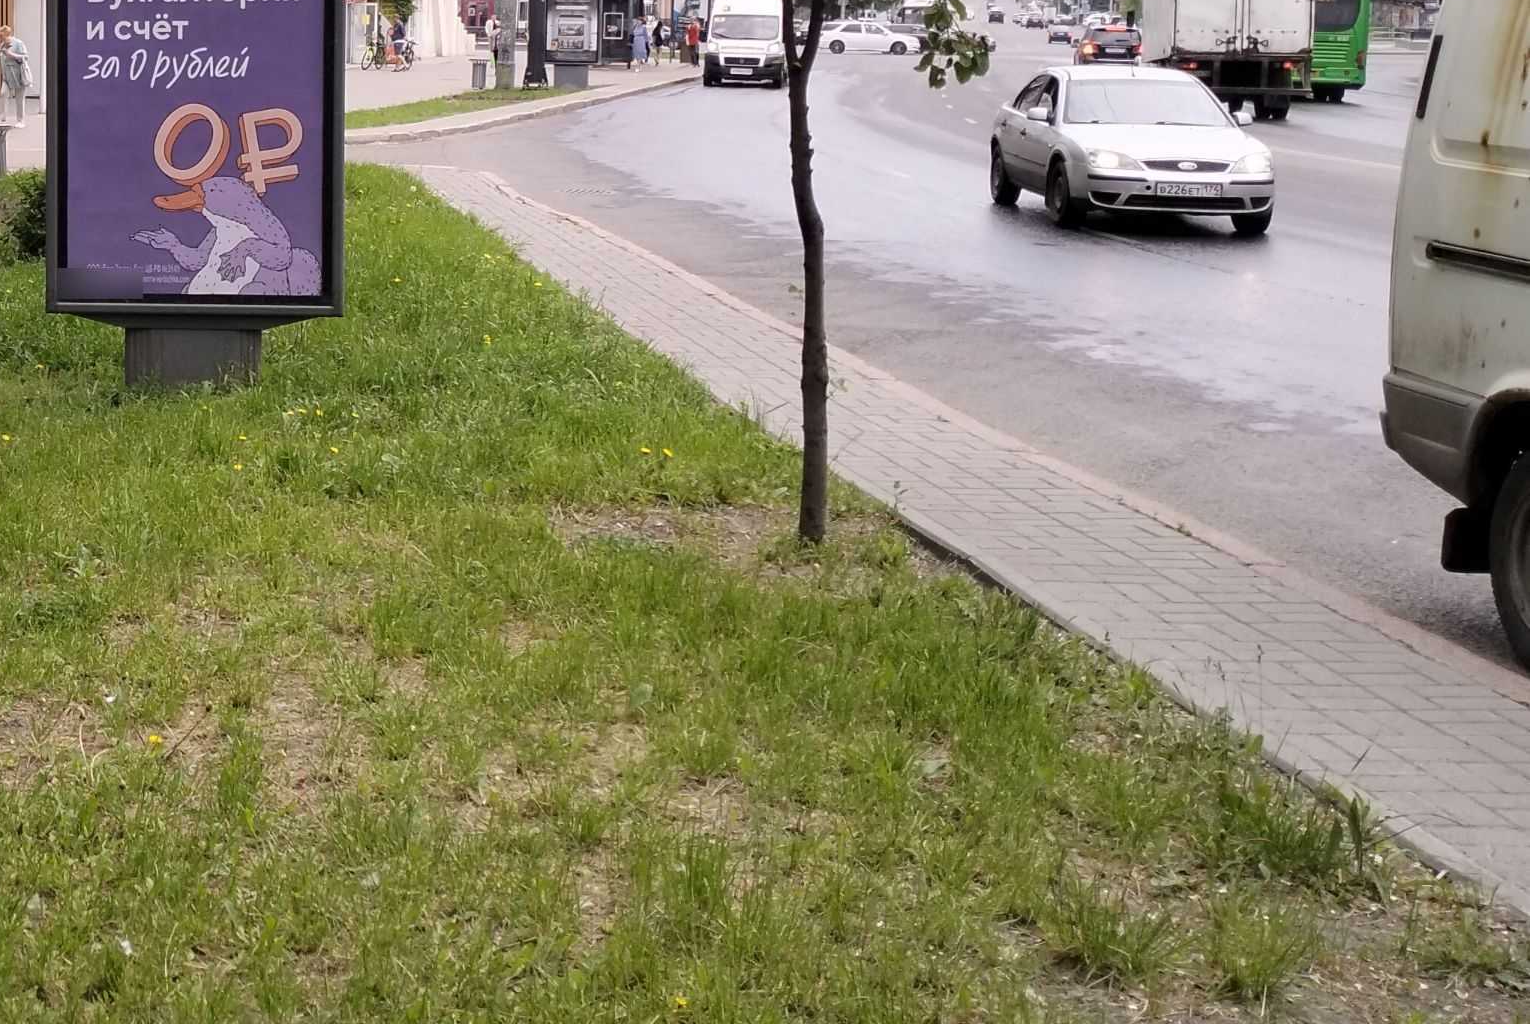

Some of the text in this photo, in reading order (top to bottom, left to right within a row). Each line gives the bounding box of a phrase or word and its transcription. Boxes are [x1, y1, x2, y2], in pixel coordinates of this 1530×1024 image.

[86, 13, 189, 41] и счёт
[82, 53, 120, 80] за
[150, 46, 250, 90] рублей
